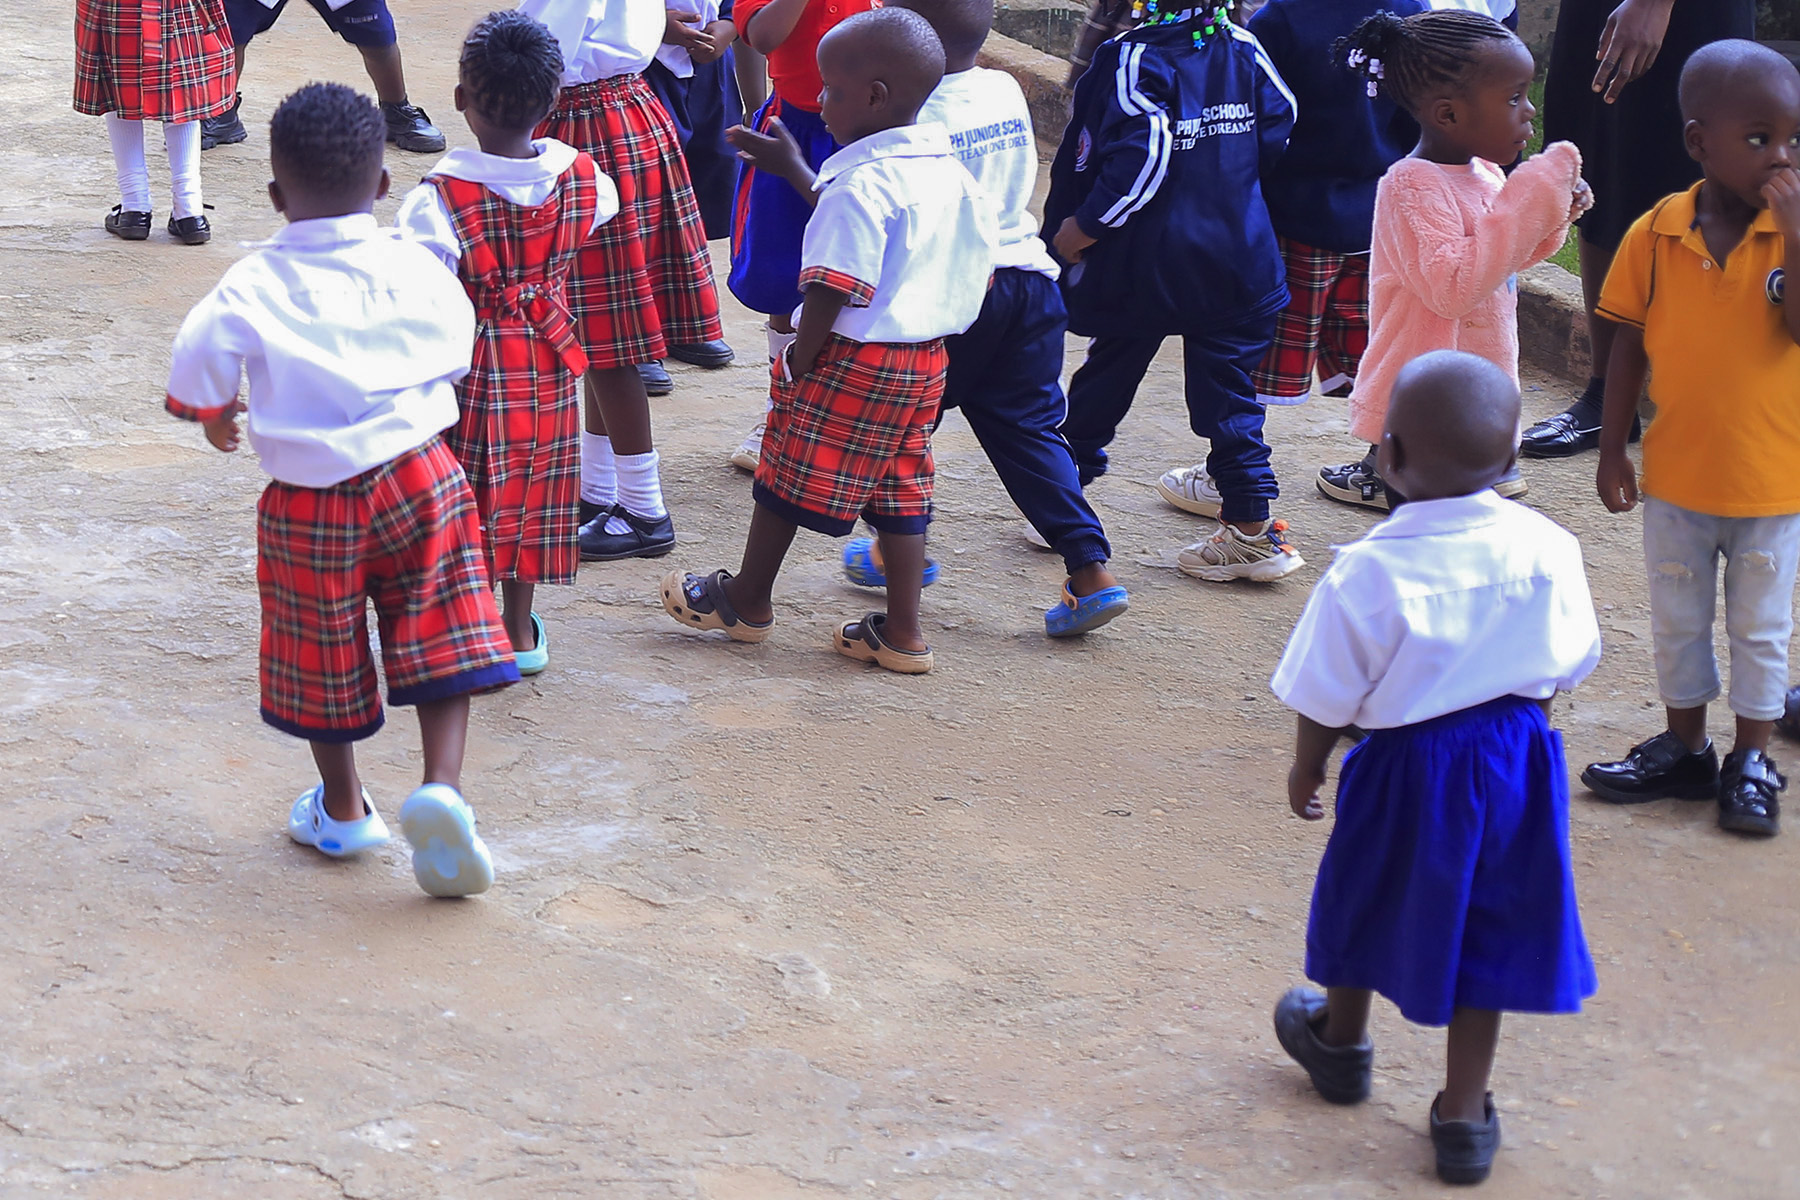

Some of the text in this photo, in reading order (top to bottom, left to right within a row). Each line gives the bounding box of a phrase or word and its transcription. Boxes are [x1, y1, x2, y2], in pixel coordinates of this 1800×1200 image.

[1202, 103, 1254, 122] SCHOOL
[965, 123, 1001, 147] JUNIOR
[958, 144, 988, 161] TEAM
[988, 139, 1007, 153] ONE
